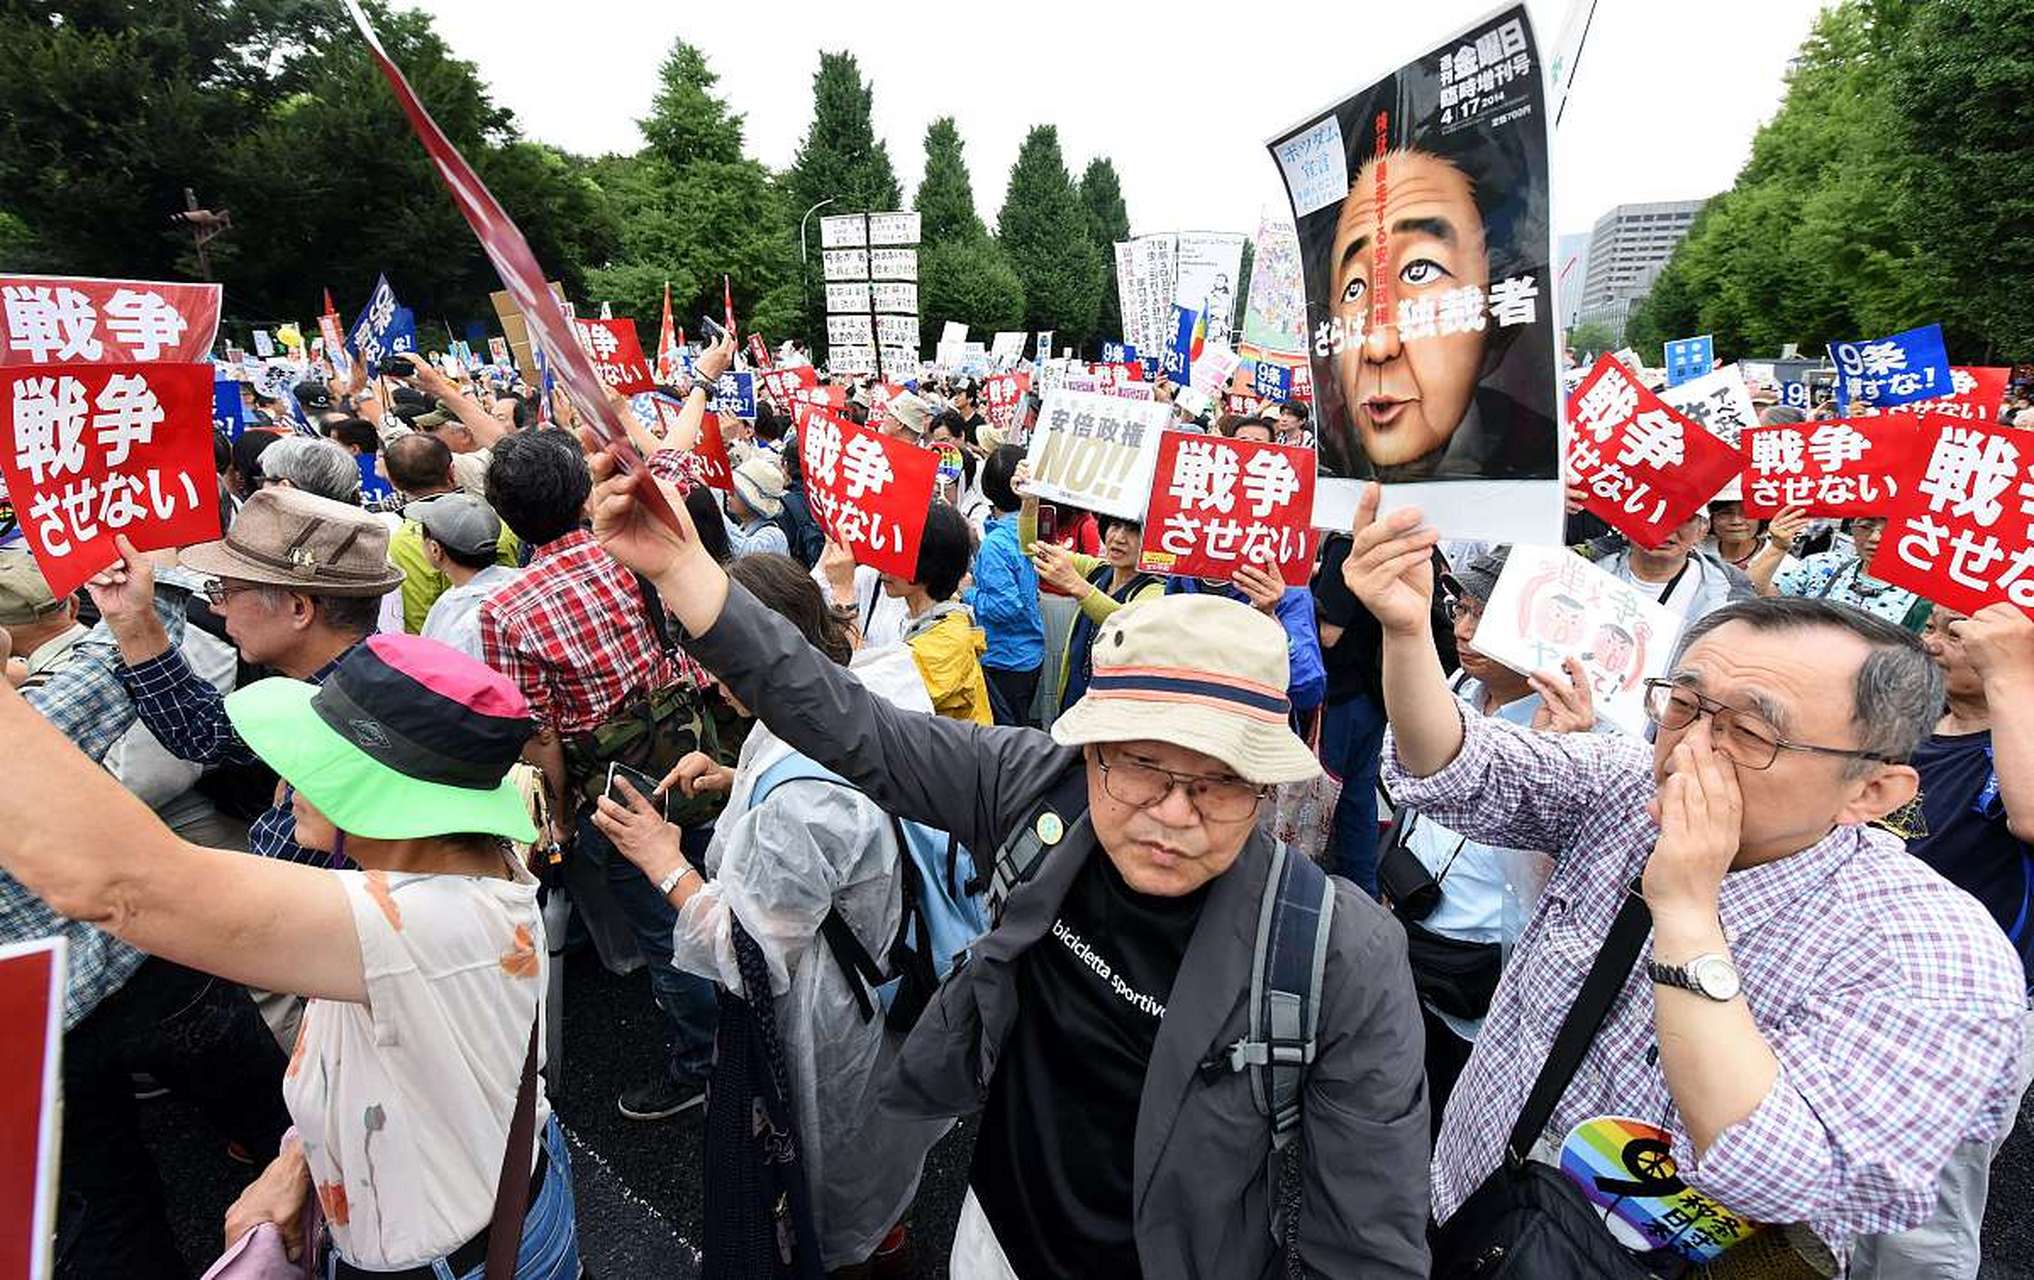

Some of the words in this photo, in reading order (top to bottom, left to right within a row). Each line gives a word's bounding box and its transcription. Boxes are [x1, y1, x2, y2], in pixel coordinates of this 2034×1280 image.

[1454, 17, 1526, 81] 金曜日
[1440, 108, 1454, 124] 4
[1461, 97, 1480, 117] 17
[1, 285, 188, 363] 戦争
[715, 375, 739, 397] 条
[1838, 341, 1908, 376] 9条
[13, 372, 167, 487] 戦争
[1050, 408, 1148, 448] 安倍政権
[1576, 366, 1686, 471] 戦争
[1751, 423, 1873, 476] 戦争
[803, 412, 895, 499] 戦争
[1033, 431, 1142, 500] NO!!
[1169, 439, 1300, 517] 戦争
[1919, 426, 2034, 543] 戦
[28, 469, 199, 557] させない
[1751, 474, 1898, 507] させない
[1161, 513, 1306, 565] させない
[1052, 919, 1111, 979] bicicletta
